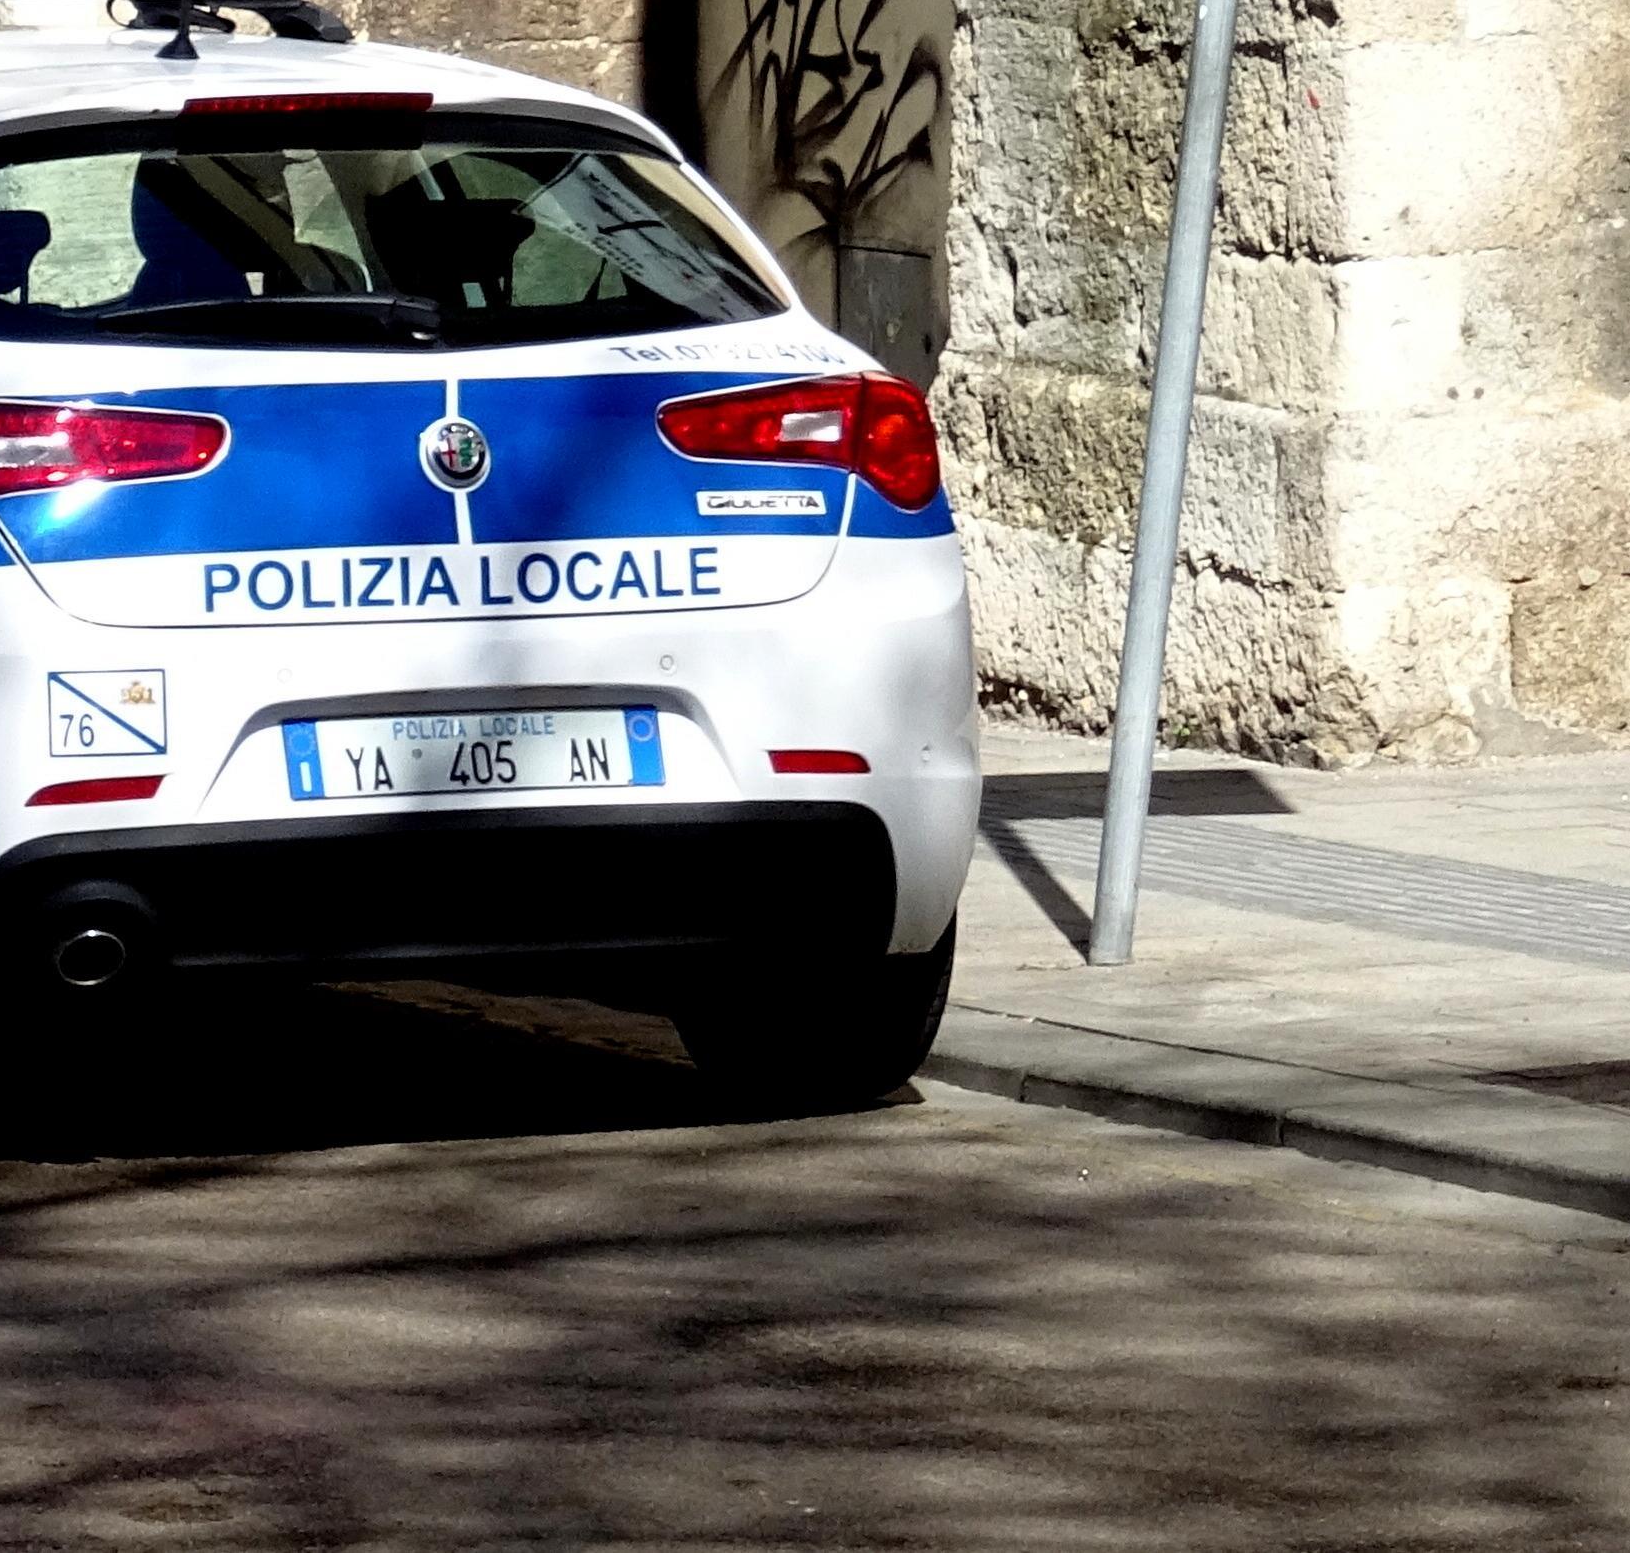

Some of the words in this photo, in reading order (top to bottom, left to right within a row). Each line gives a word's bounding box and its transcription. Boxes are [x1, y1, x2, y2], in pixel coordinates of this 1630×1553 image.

[202, 556, 461, 613] POLIZIA
[479, 546, 722, 607] LOCALE
[59, 713, 95, 748] 76
[392, 718, 468, 741] POLIZIA
[479, 715, 556, 738] LOCALE
[346, 747, 393, 791] YA
[449, 739, 517, 786] 405
[570, 738, 611, 782] AN
